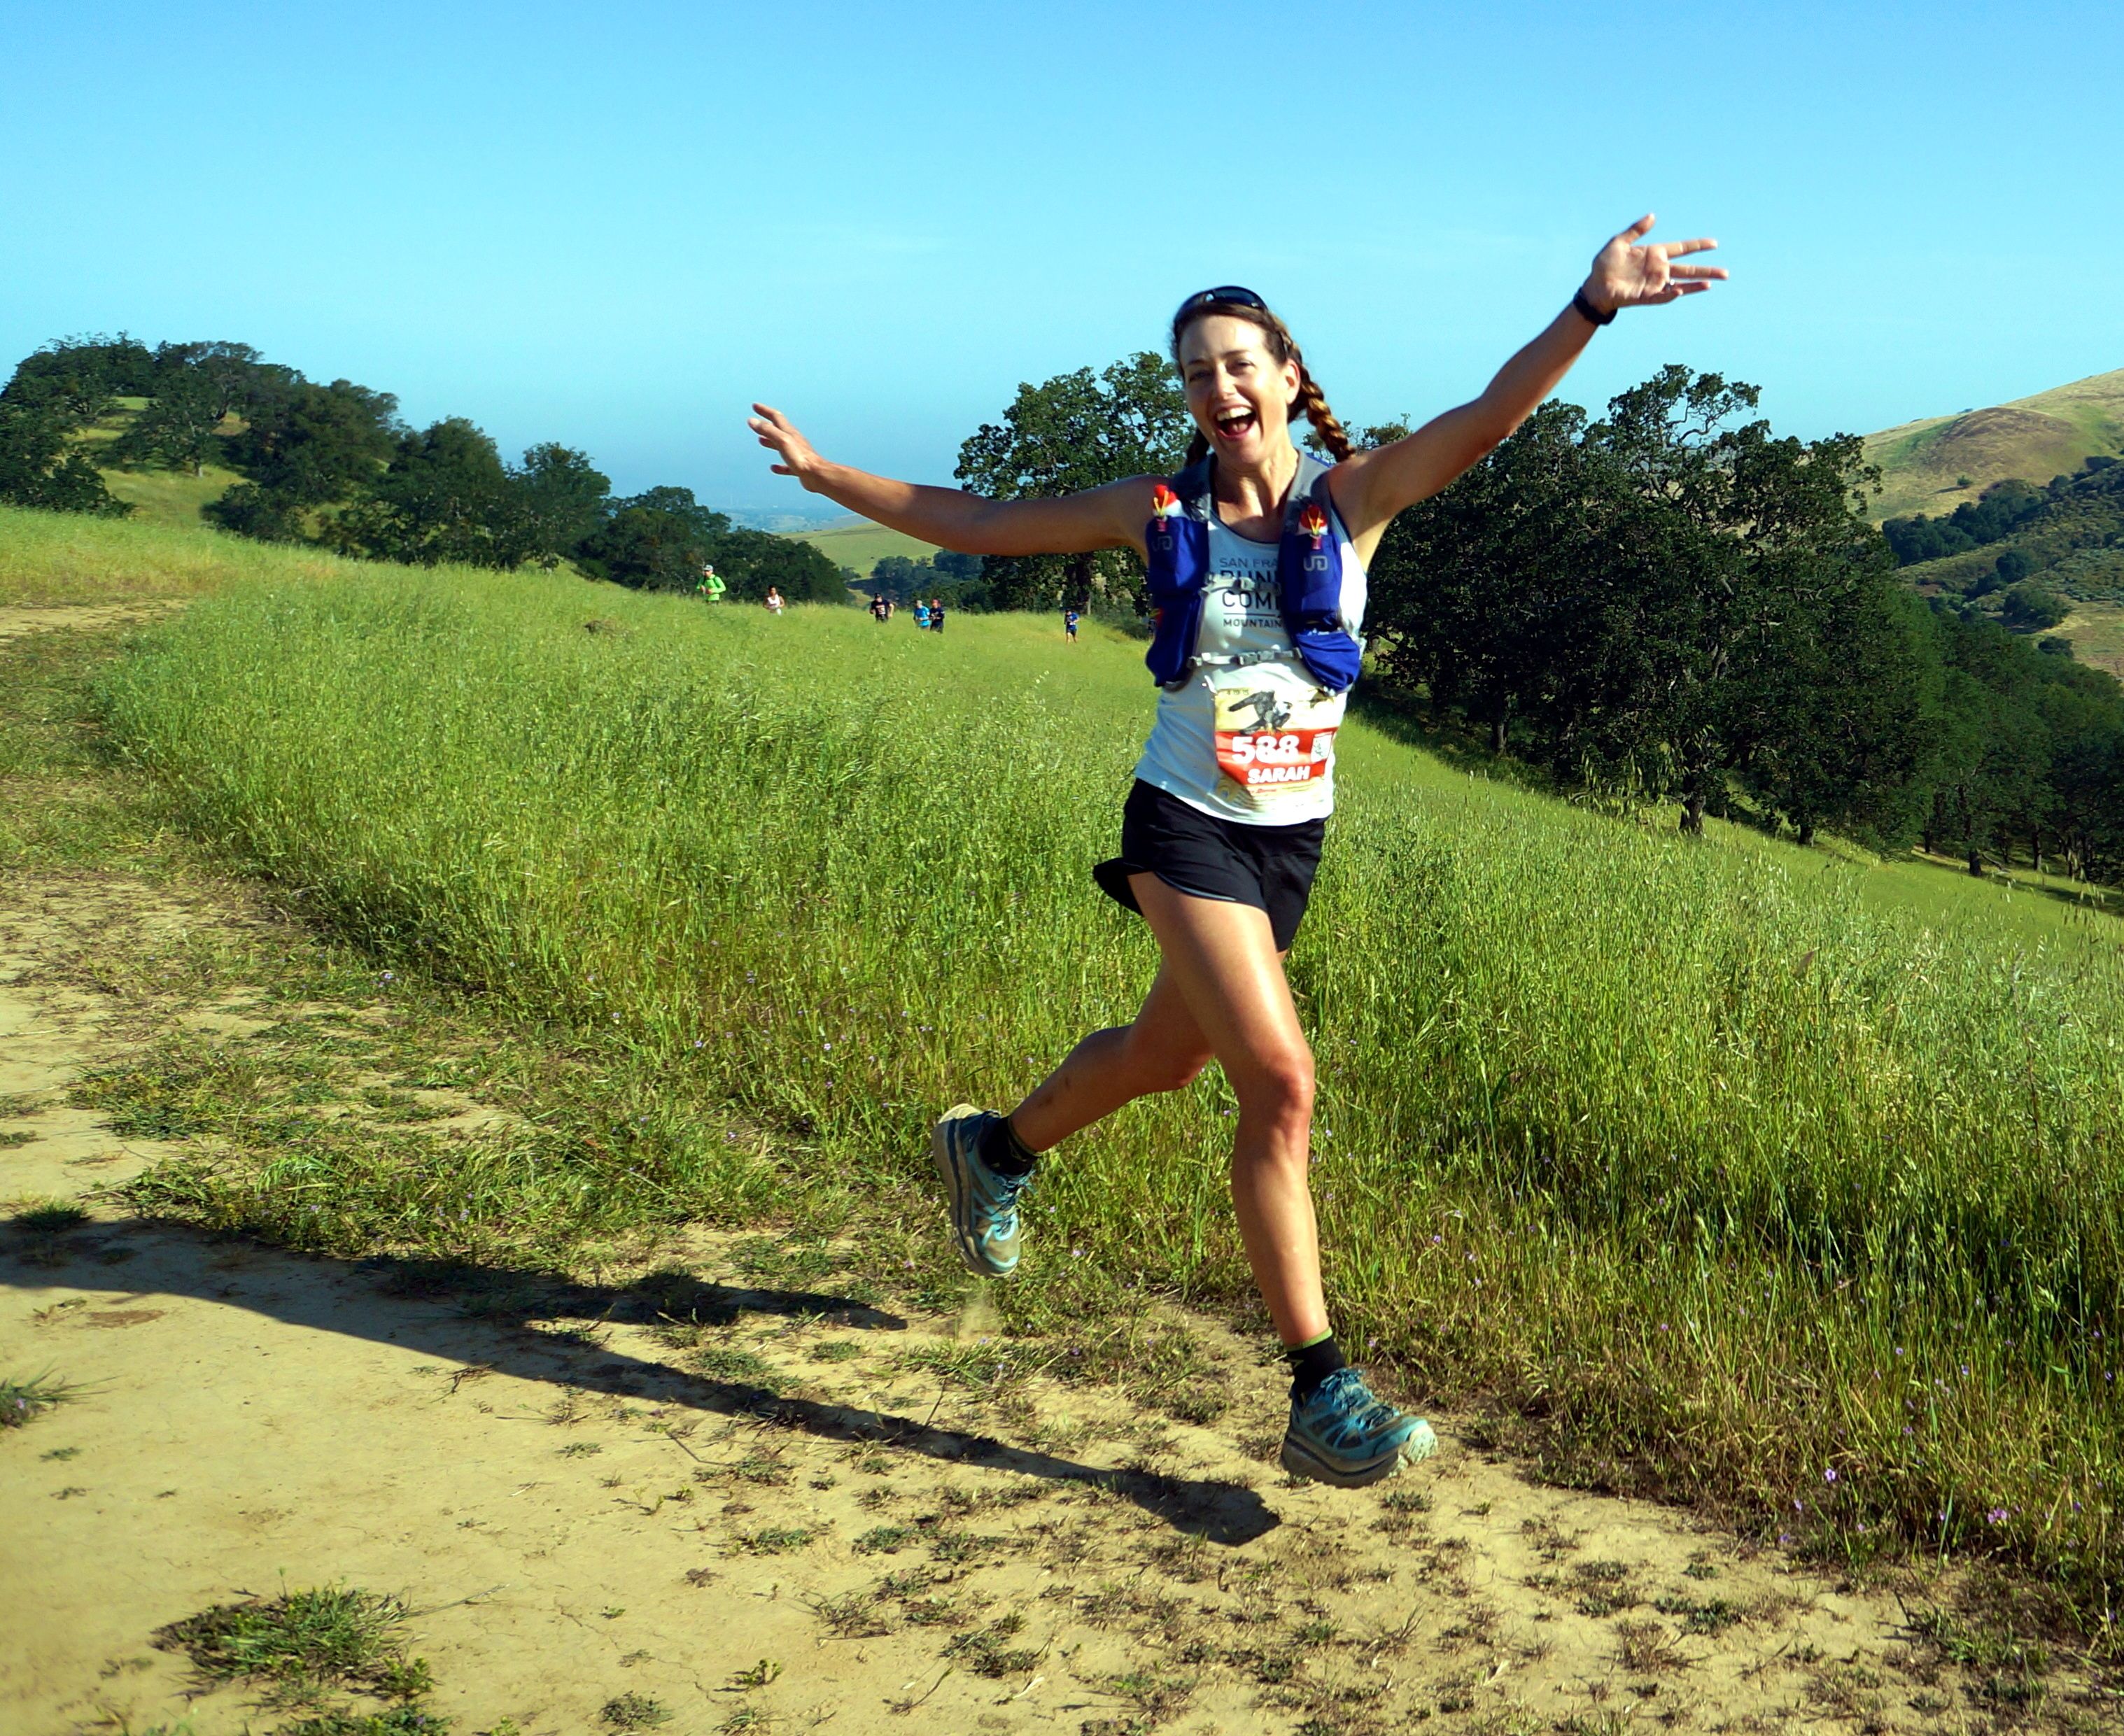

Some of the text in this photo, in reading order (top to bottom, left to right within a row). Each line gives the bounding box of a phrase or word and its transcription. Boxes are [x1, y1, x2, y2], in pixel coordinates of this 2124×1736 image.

[1219, 558, 1248, 568] SAN
[1223, 619, 1283, 628] MOUNTAIN
[1232, 735, 1300, 764] 588
[1247, 765, 1311, 784] SARAH
